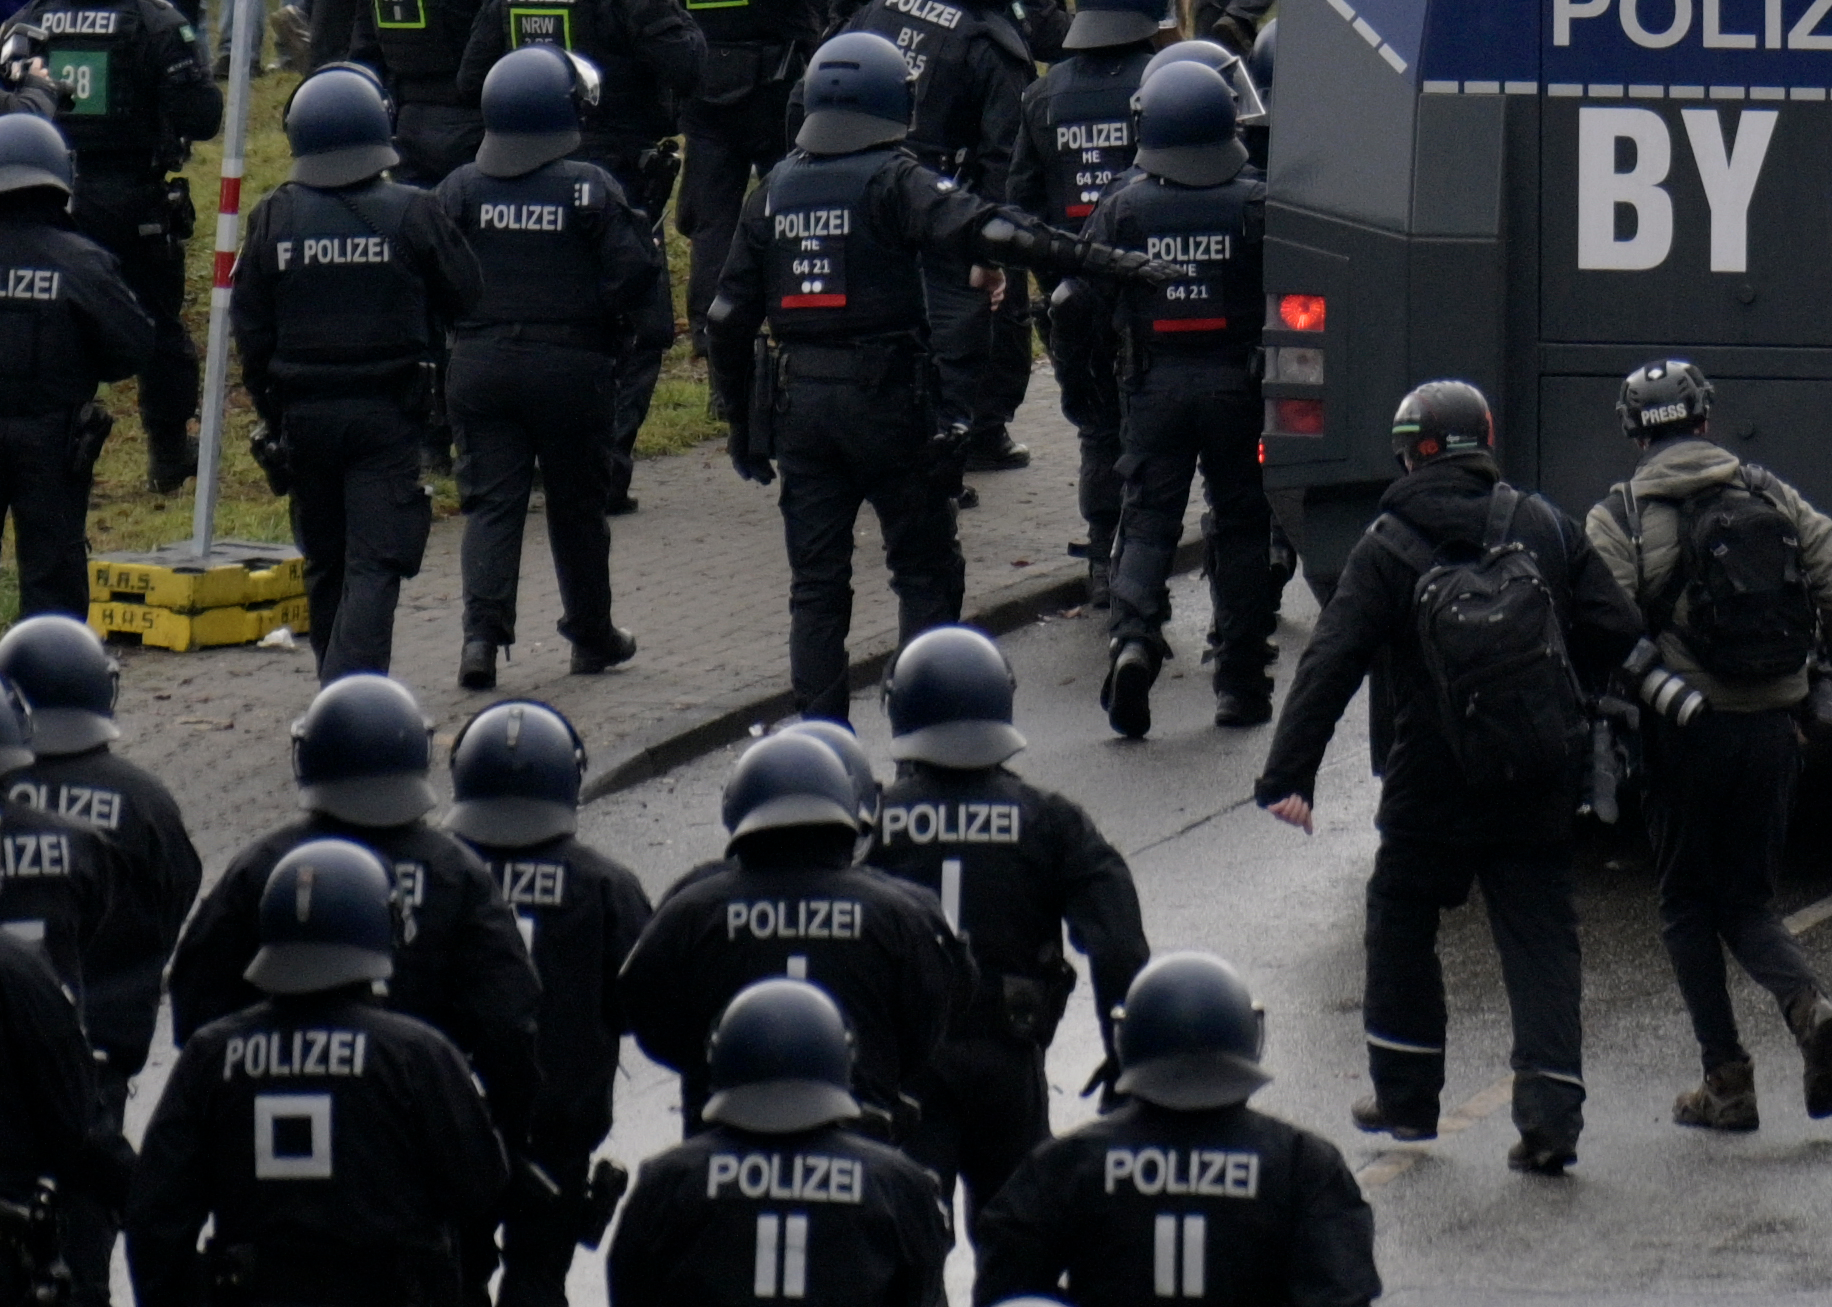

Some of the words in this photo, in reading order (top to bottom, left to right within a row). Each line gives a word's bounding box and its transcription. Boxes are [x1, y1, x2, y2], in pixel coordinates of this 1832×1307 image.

[41, 11, 116, 34] POLIZEI
[522, 17, 553, 34] NRW
[897, 27, 925, 49] BY
[901, 50, 927, 73] 55
[1057, 123, 1128, 150] POLIZEI
[1076, 172, 1092, 186] 64
[1577, 107, 1779, 272] BY
[480, 204, 563, 231] POLIZEI
[775, 210, 850, 239] POLIZEI
[304, 237, 390, 264] POLIZEI
[1147, 235, 1230, 261] POLIZEI
[792, 259, 809, 274] 64
[813, 258, 830, 273] 21
[0, 270, 59, 301] IZEI
[1166, 286, 1186, 300] 64
[1189, 285, 1208, 299] 21
[1641, 401, 1687, 427] PRESS
[883, 804, 1019, 844] POLIZEI
[0, 834, 70, 877] IZEI
[502, 862, 564, 905] IZEI
[727, 901, 861, 939] POLIZEI
[224, 1032, 365, 1081] POLIZEI
[707, 1154, 862, 1203] POLIZEI
[1105, 1149, 1259, 1199] POLIZEI
